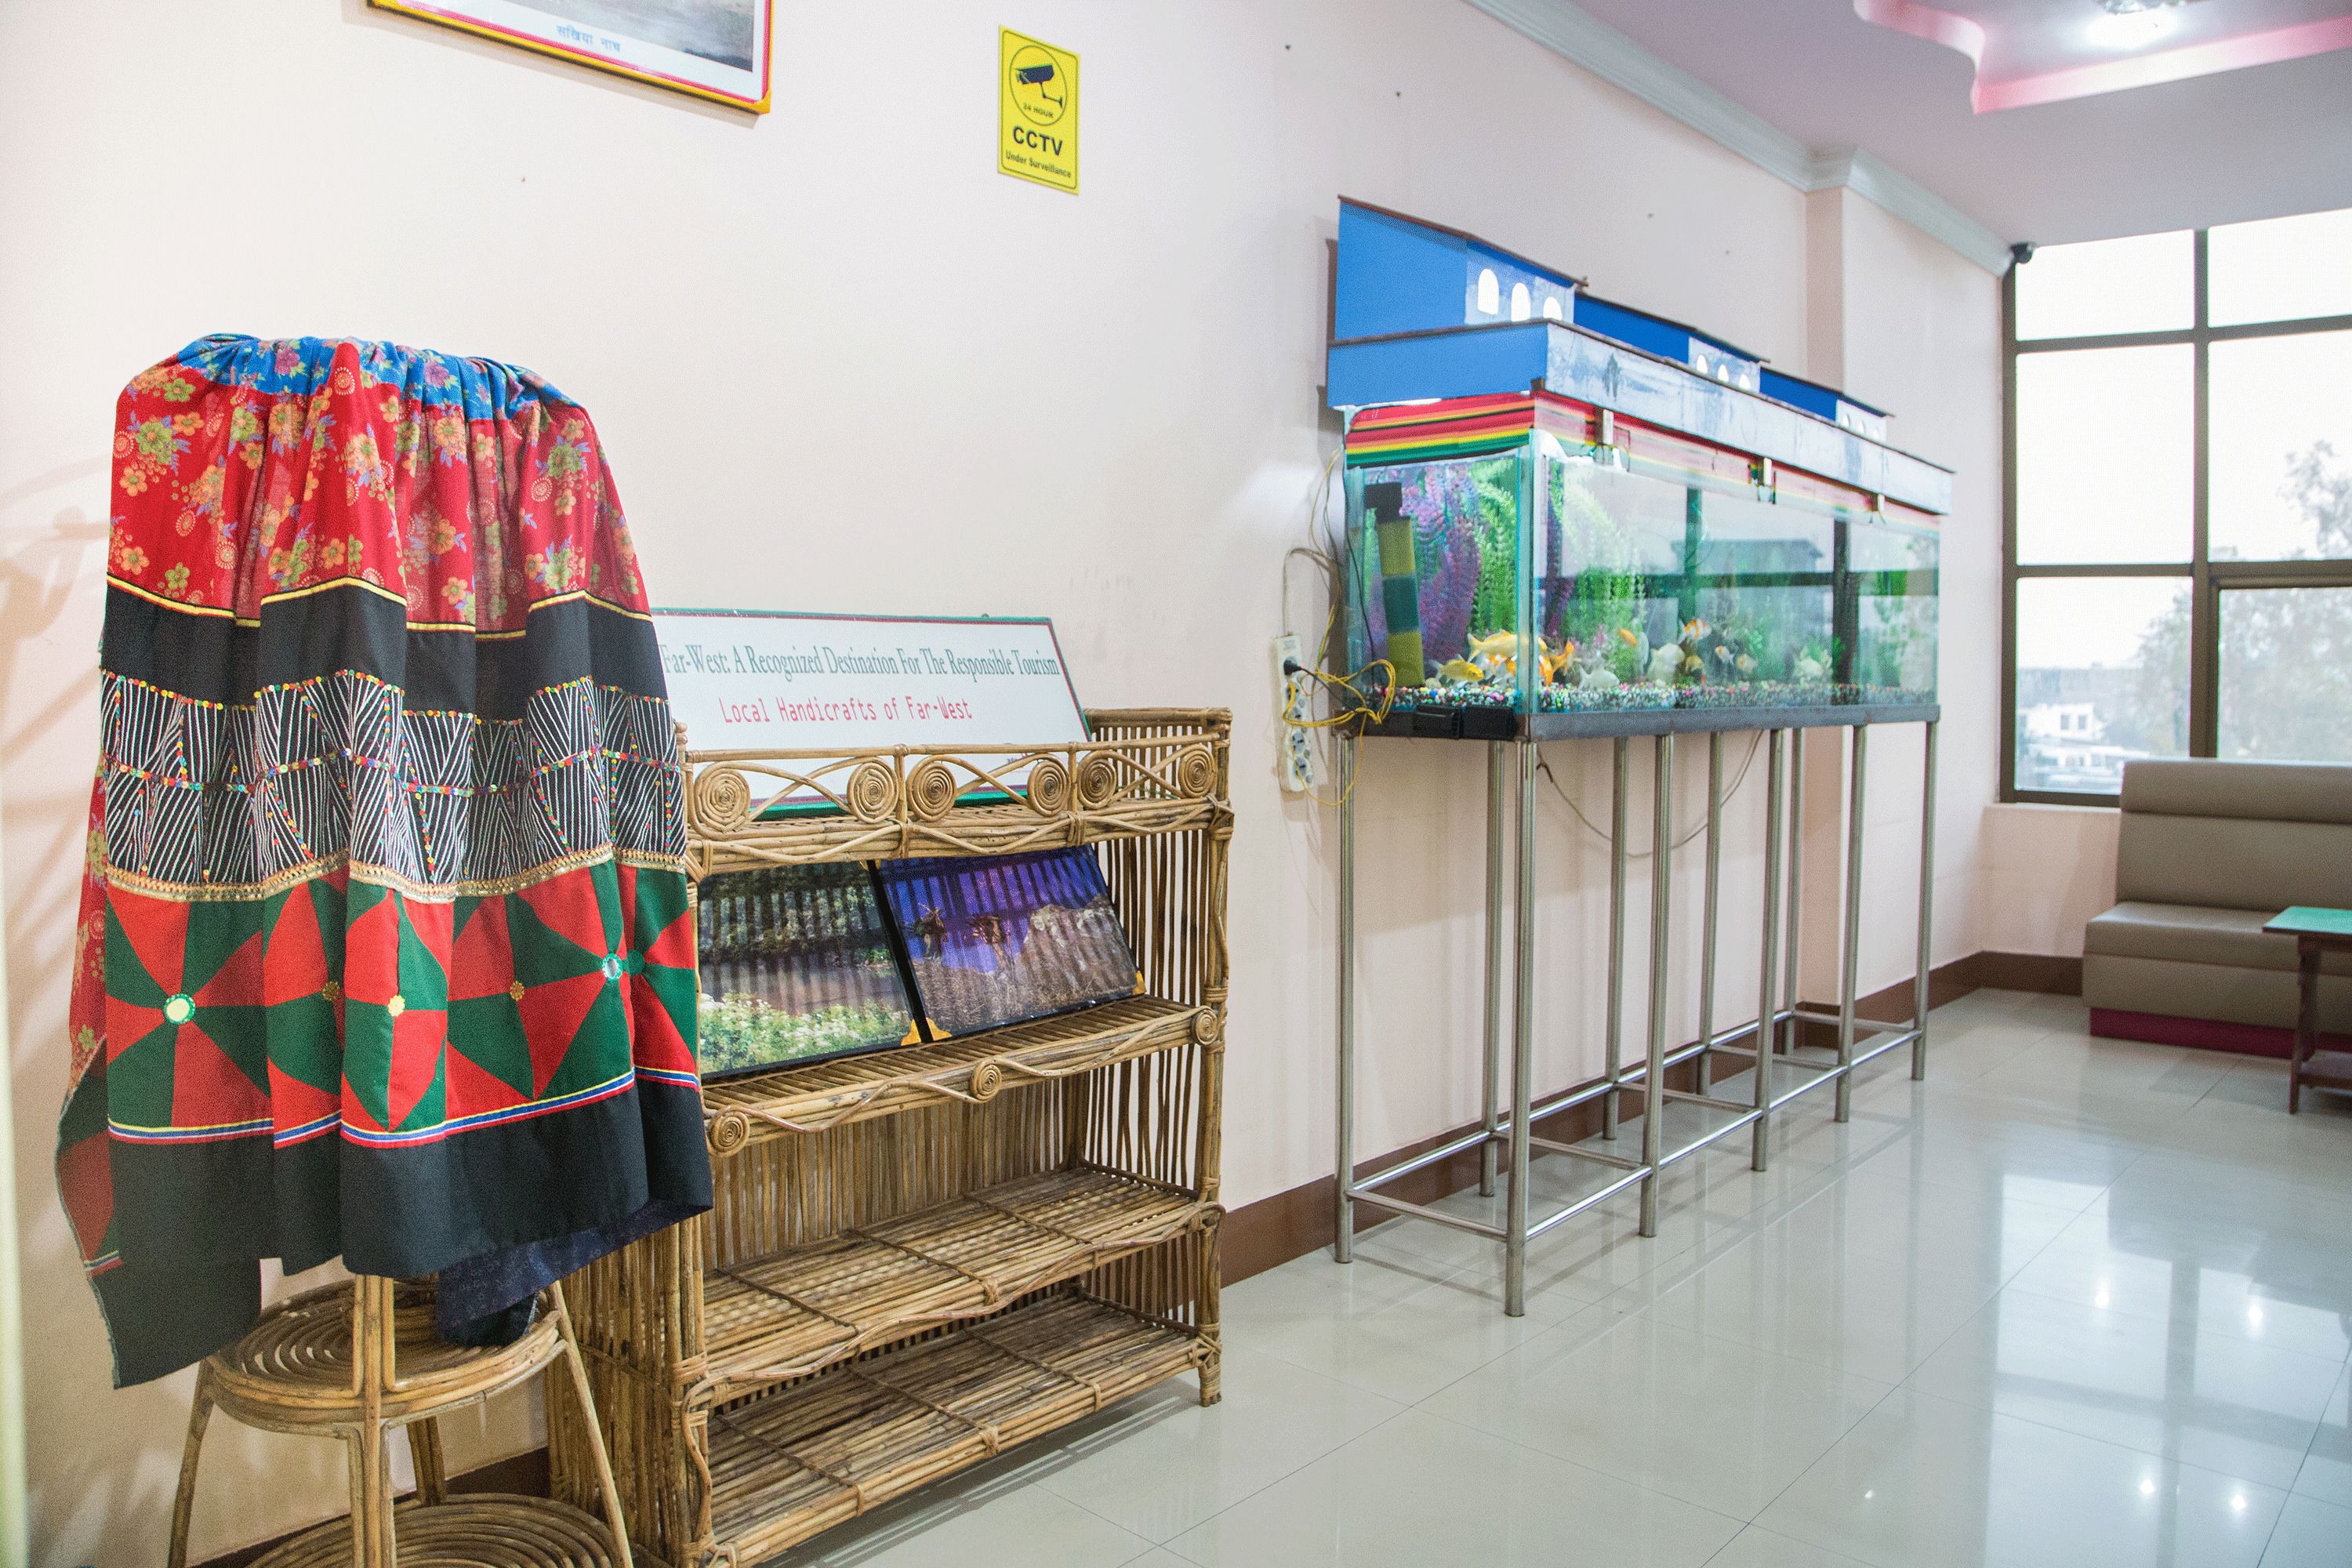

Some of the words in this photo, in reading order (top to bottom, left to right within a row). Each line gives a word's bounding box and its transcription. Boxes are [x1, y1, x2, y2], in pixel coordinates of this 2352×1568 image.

[1013, 125, 1063, 156] CCTV
[1006, 149, 1026, 165] Under
[1029, 157, 1072, 178] Surveillance
[659, 644, 731, 674] Far-West:
[732, 644, 746, 674] A
[744, 645, 824, 683] Recognized
[822, 646, 899, 675] Destination
[896, 648, 924, 675] For
[920, 648, 947, 675] The
[945, 648, 1014, 683] Responsible
[1011, 649, 1060, 675] Tourism
[719, 697, 771, 723] Local
[775, 695, 877, 722] Handicrafts
[884, 697, 900, 720] of
[905, 695, 973, 720] Far-West
